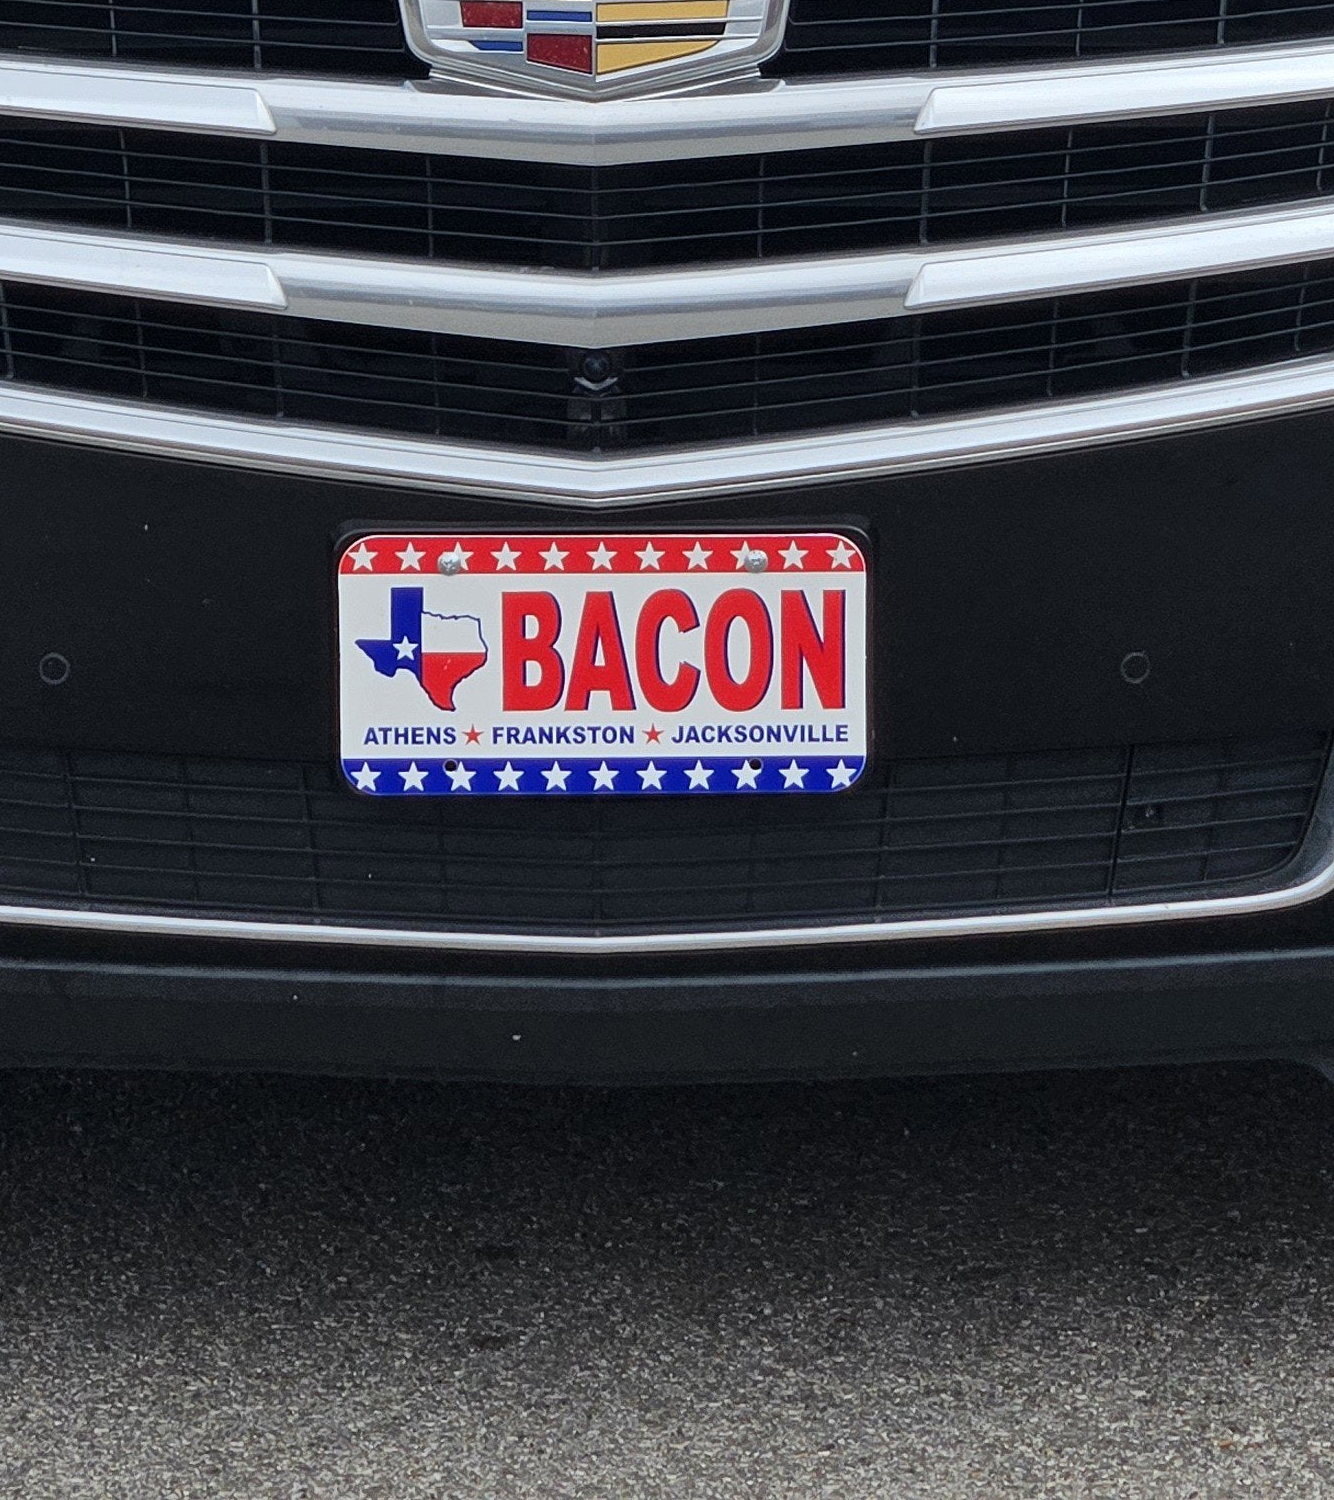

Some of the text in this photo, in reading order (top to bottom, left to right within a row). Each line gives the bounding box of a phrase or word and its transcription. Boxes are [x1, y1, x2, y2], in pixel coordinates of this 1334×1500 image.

[501, 588, 847, 712] BACON
[363, 724, 849, 746] ATHENS FRANKSTON JACKSONVILLE
